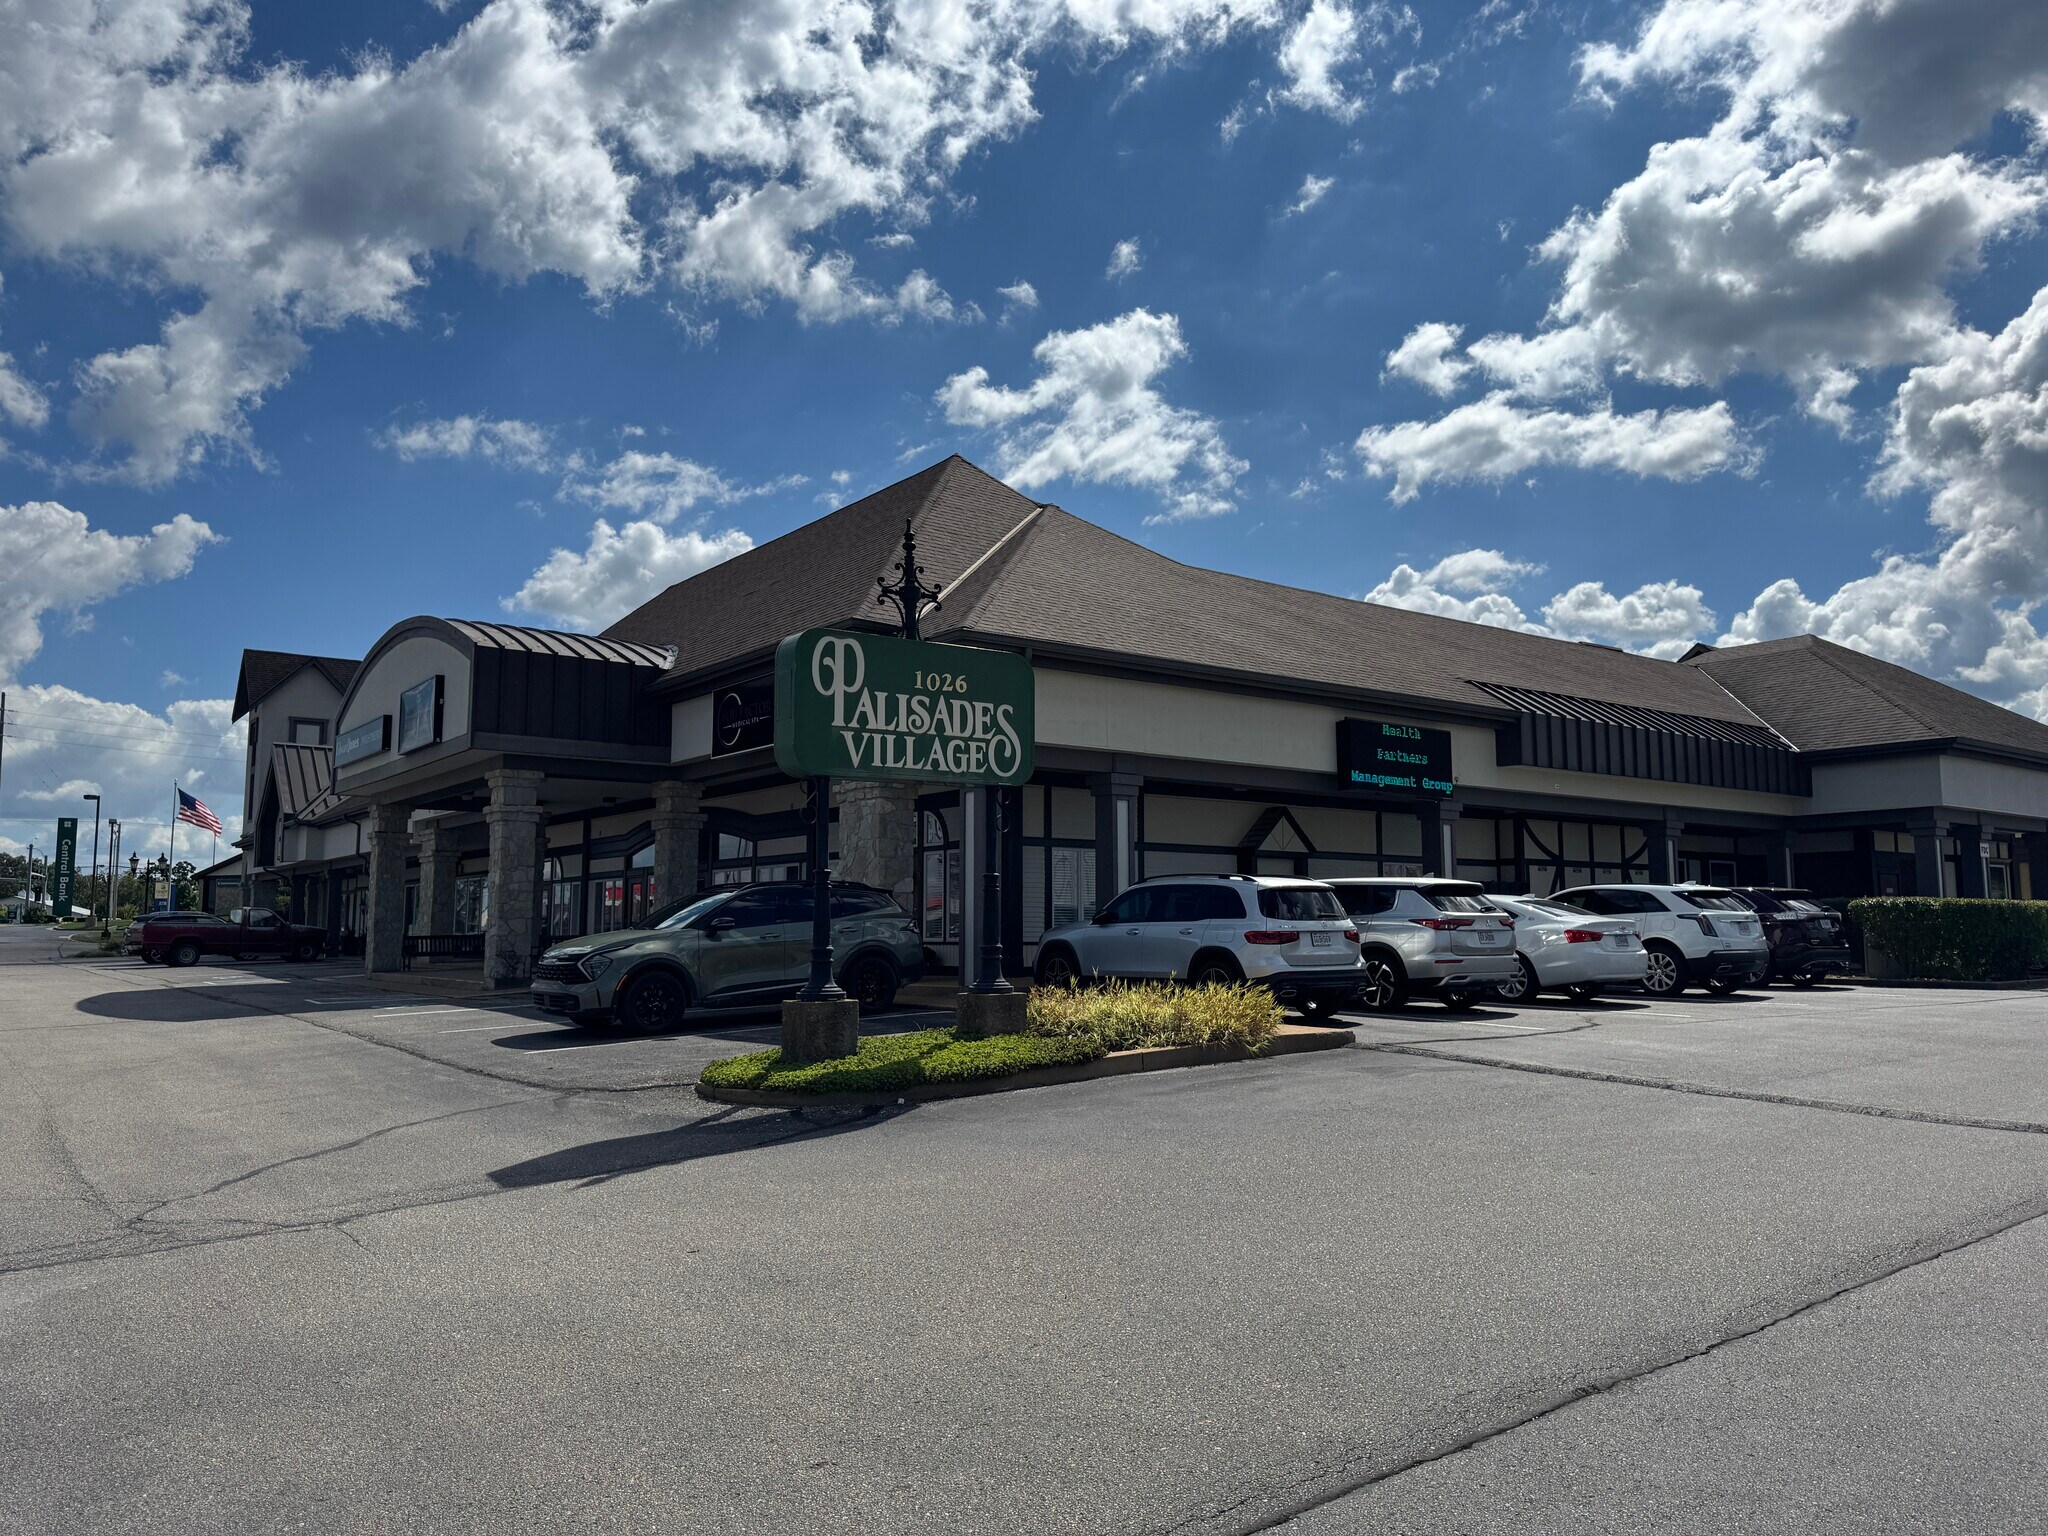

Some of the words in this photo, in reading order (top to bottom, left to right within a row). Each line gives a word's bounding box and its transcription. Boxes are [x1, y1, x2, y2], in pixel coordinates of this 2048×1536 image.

[913, 670, 968, 694] 1026
[811, 635, 1022, 778] PALISADES
[751, 716, 760, 724] SPA
[1382, 724, 1421, 740] Health
[840, 730, 990, 774] VILLAGE
[1376, 748, 1428, 765] Partners
[1351, 770, 1417, 788] Management
[1422, 777, 1453, 794] Group
[60, 839, 72, 874] Central
[58, 876, 69, 902] Bank
